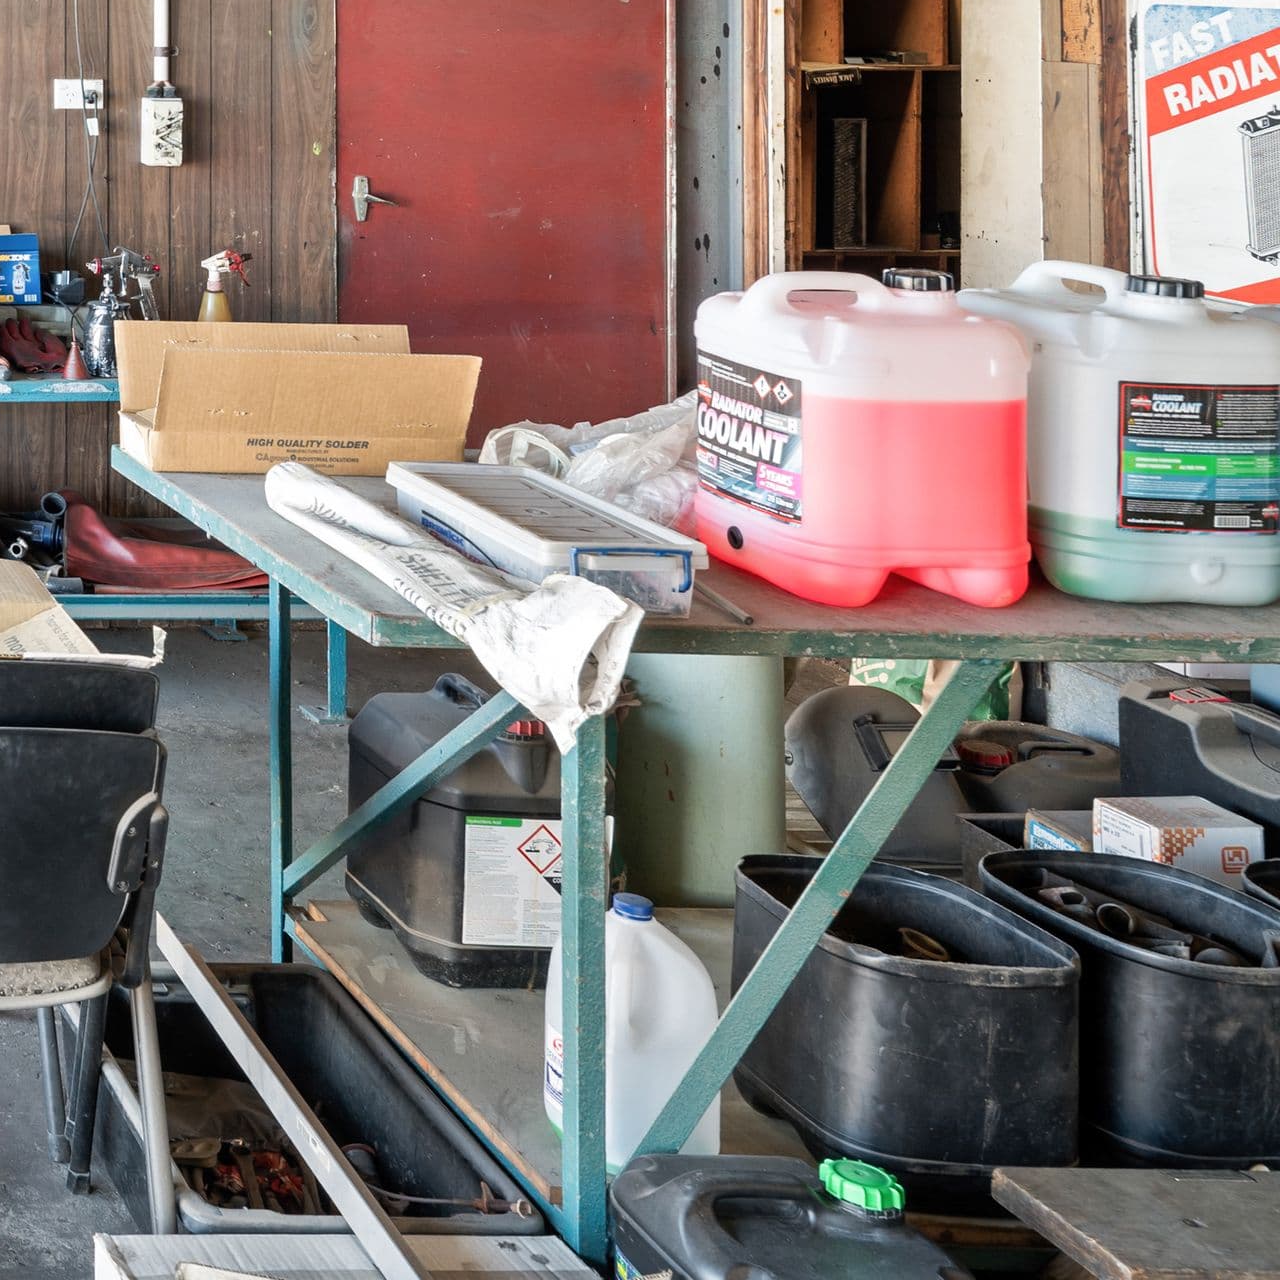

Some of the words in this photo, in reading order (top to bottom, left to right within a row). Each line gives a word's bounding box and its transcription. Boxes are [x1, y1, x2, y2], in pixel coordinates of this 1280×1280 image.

[1150, 10, 1233, 71] FAST
[711, 390, 763, 425] RADIATOR
[1152, 401, 1203, 414] COOLANT
[246, 438, 274, 447] HIGH
[276, 439, 323, 449] QUALITY
[325, 440, 370, 449] SOLDER
[698, 402, 790, 465] COOLANT
